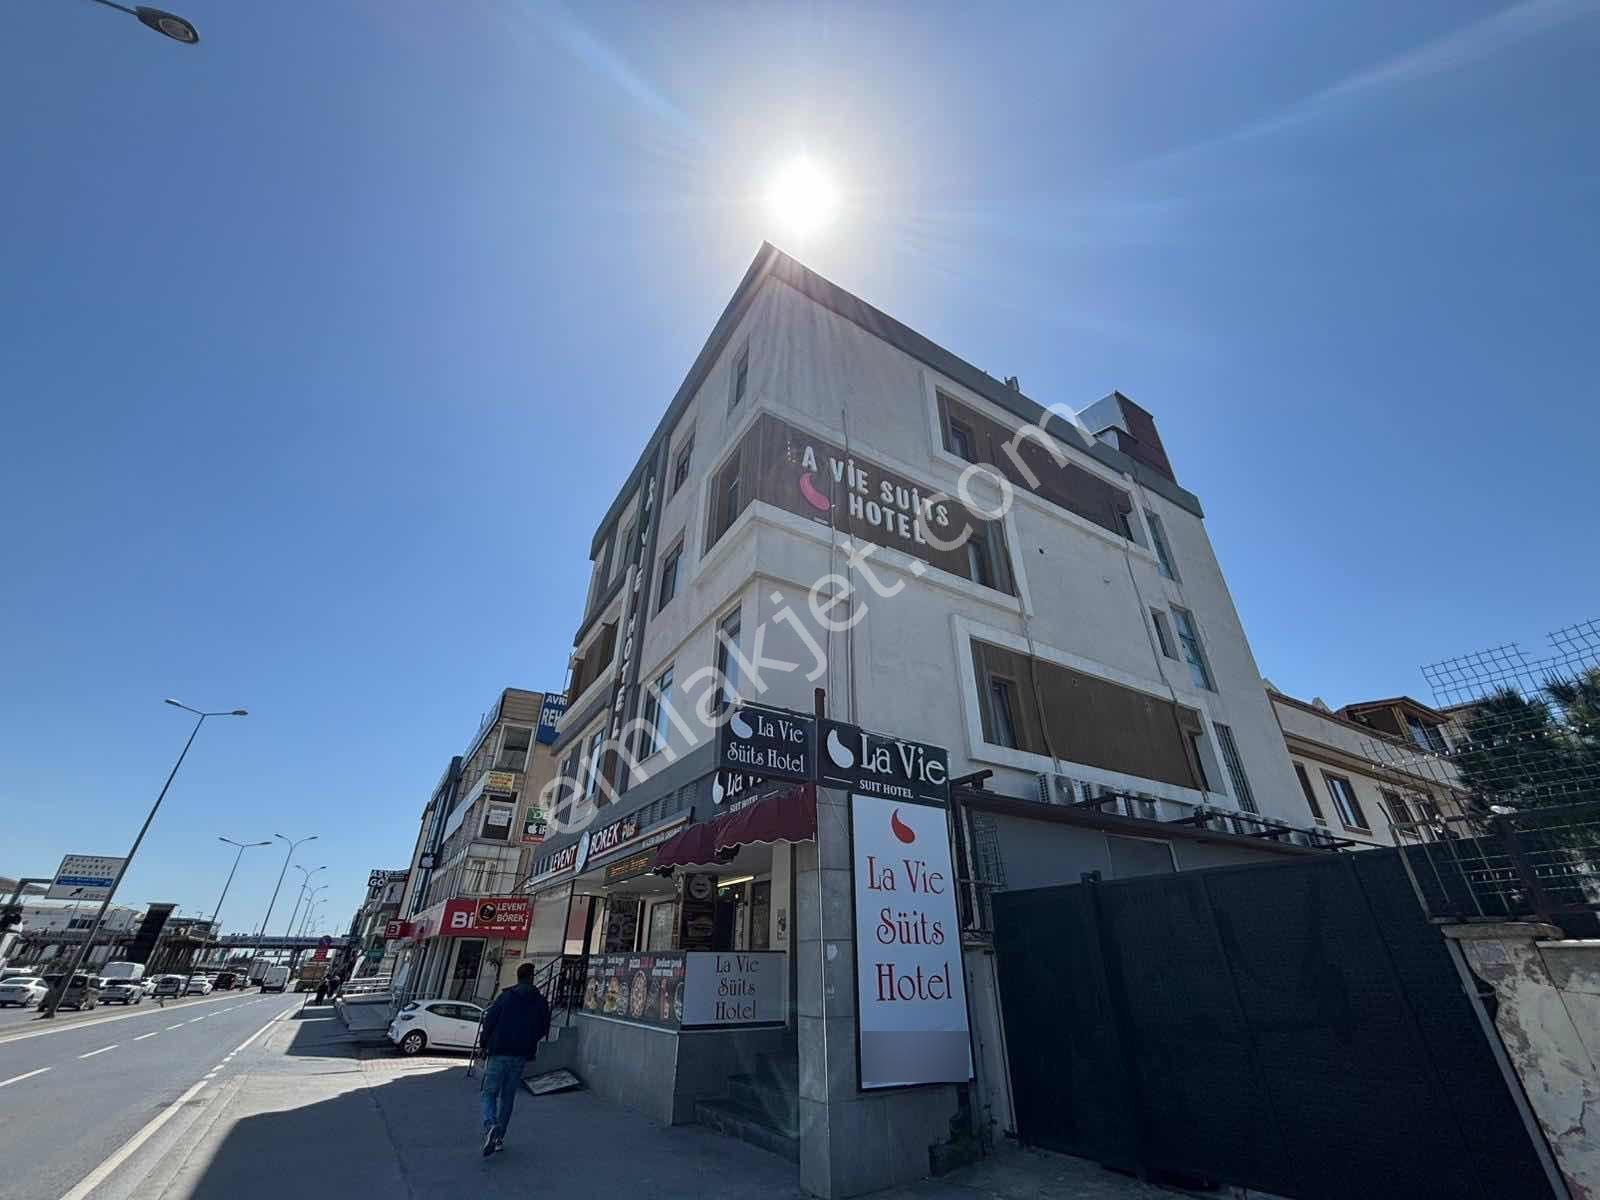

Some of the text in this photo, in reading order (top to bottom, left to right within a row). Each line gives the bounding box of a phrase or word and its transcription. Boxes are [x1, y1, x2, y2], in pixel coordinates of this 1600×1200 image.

[849, 493, 927, 545] HOTEL
[758, 715, 804, 744] La Vie
[727, 741, 805, 773] Süits Hotel
[860, 733, 947, 785] La Vie
[859, 779, 914, 799] SUIT HOTEL
[549, 844, 577, 873] LEVENT
[866, 855, 945, 895] La Vie
[497, 902, 528, 911] LEVENT
[876, 907, 945, 945] Süits
[716, 955, 761, 974] La Vie
[718, 977, 756, 997] Süits
[875, 961, 952, 1002] Hotel
[715, 1000, 757, 1020] Hotel
